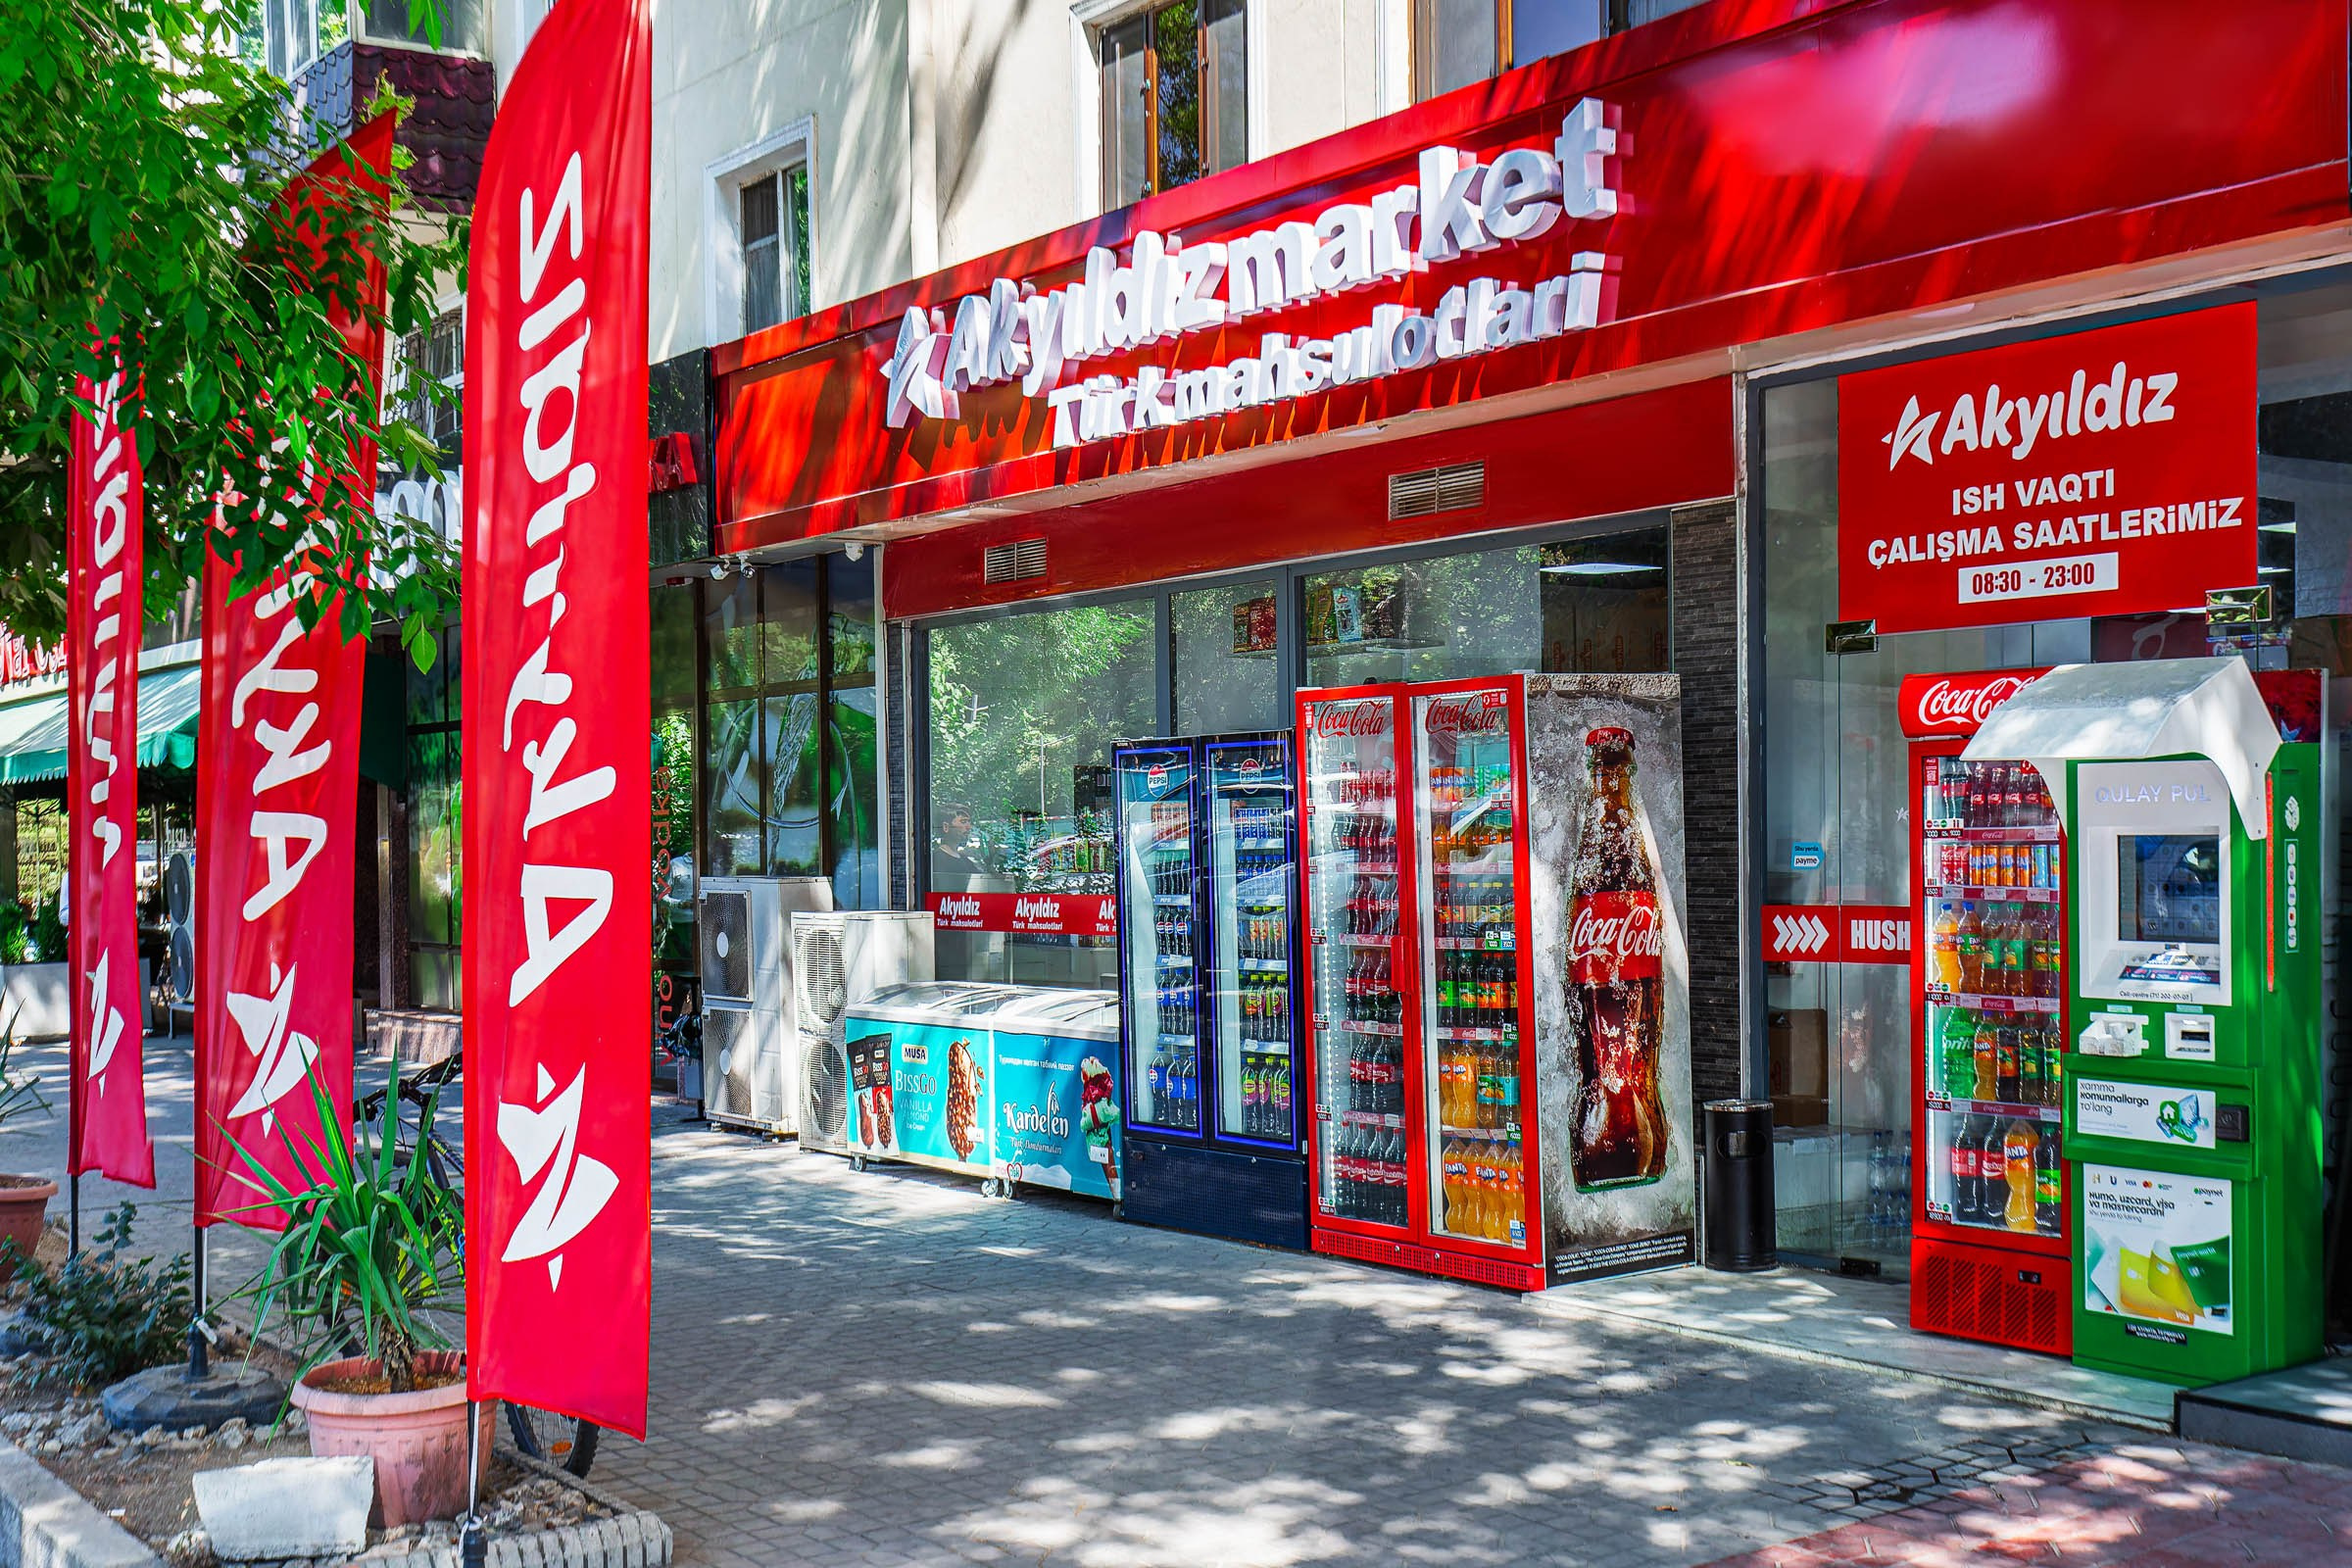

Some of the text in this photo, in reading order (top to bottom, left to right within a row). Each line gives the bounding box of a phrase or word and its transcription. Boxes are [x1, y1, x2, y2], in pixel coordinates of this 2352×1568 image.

[1940, 362, 2179, 461] Akyıldız
[1952, 468, 2116, 516] ISH VAQTI
[1868, 527, 2004, 571] ÇALIŞMA
[1972, 568, 2022, 596] 08:30
[2043, 562, 2095, 590] 23:00
[1317, 700, 1387, 739] Coca-Cola
[2171, 784, 2212, 803] PUL
[652, 766, 672, 902] vodka
[939, 896, 980, 919] Akyıldız
[1014, 897, 1059, 922] Akyıldız
[1568, 906, 1661, 960] Coca-Cola
[1850, 918, 1911, 951] HUSH
[905, 1048, 926, 1059] MUSA
[899, 1100, 933, 1113] VANILLA
[1003, 1081, 1069, 1139] Kardelen
